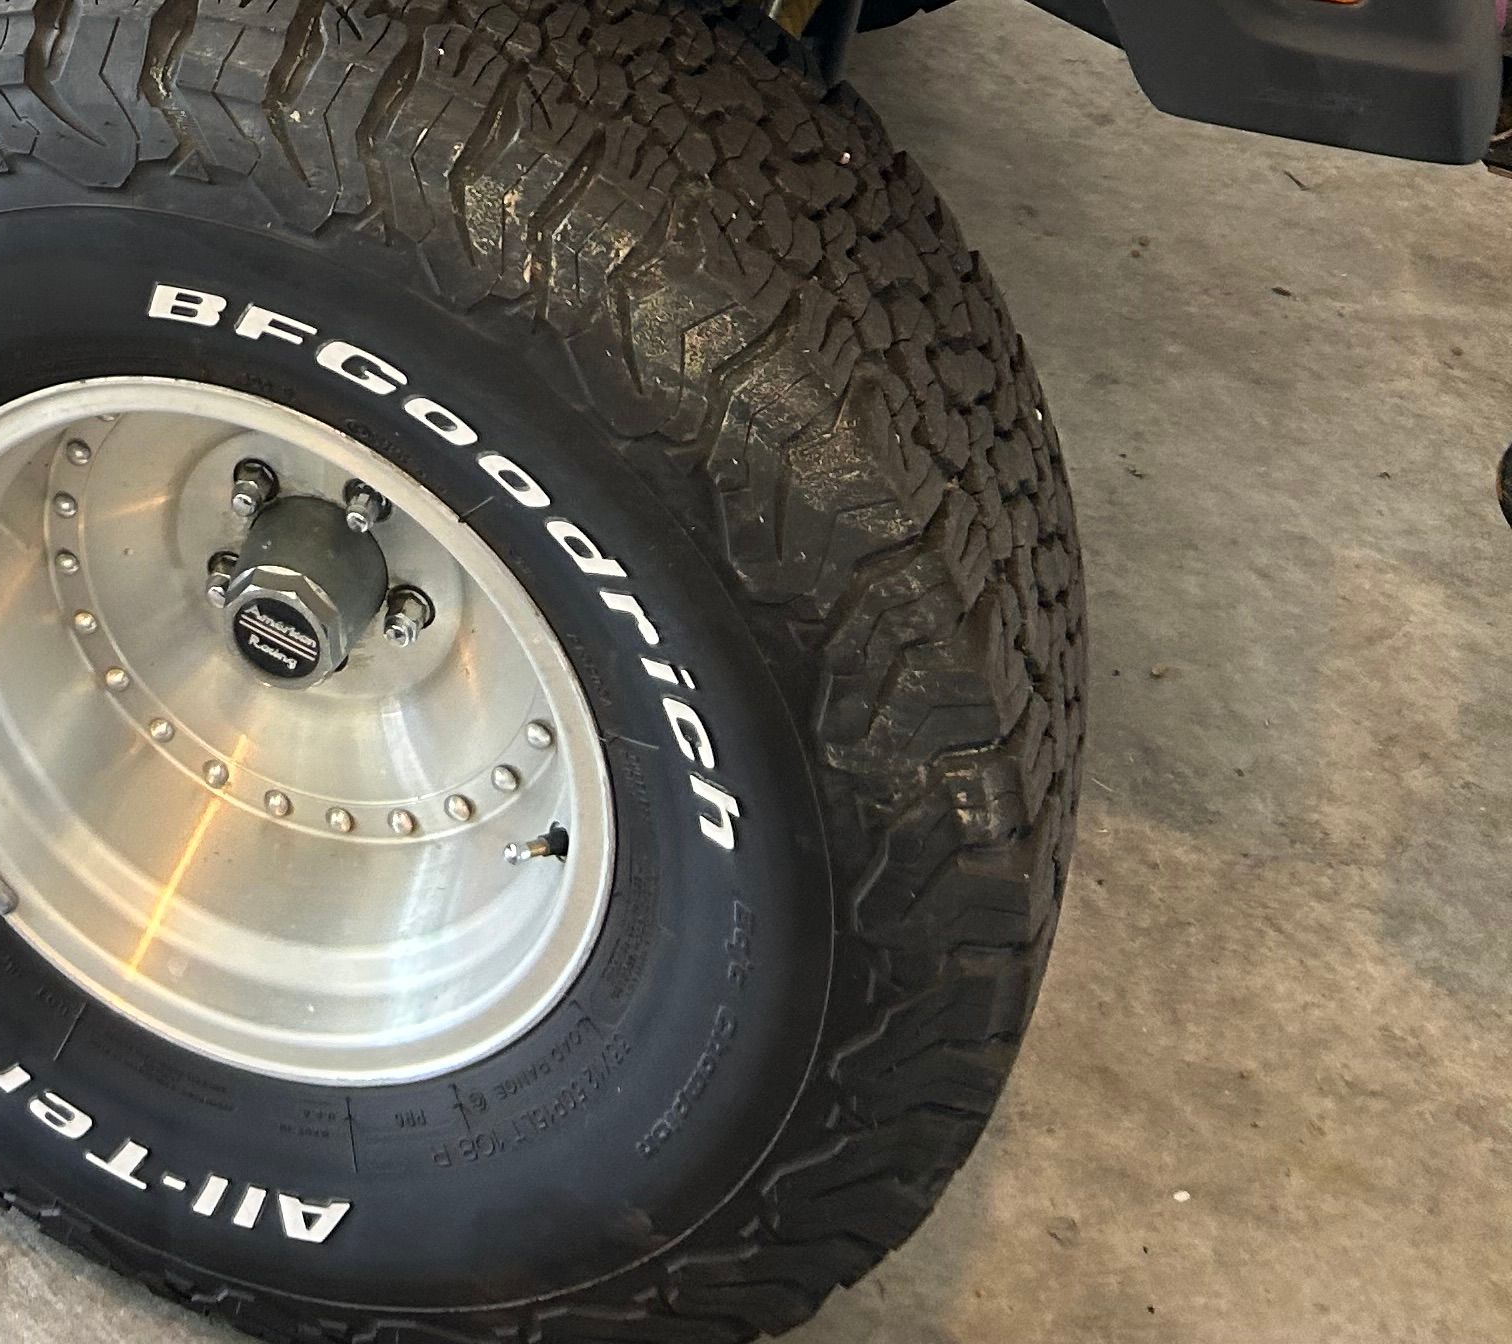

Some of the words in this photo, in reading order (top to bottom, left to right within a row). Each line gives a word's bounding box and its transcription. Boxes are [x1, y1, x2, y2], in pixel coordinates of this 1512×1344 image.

[147, 281, 741, 850] BFGoodrich
[243, 604, 317, 649] American
[248, 633, 298, 670] Racing
